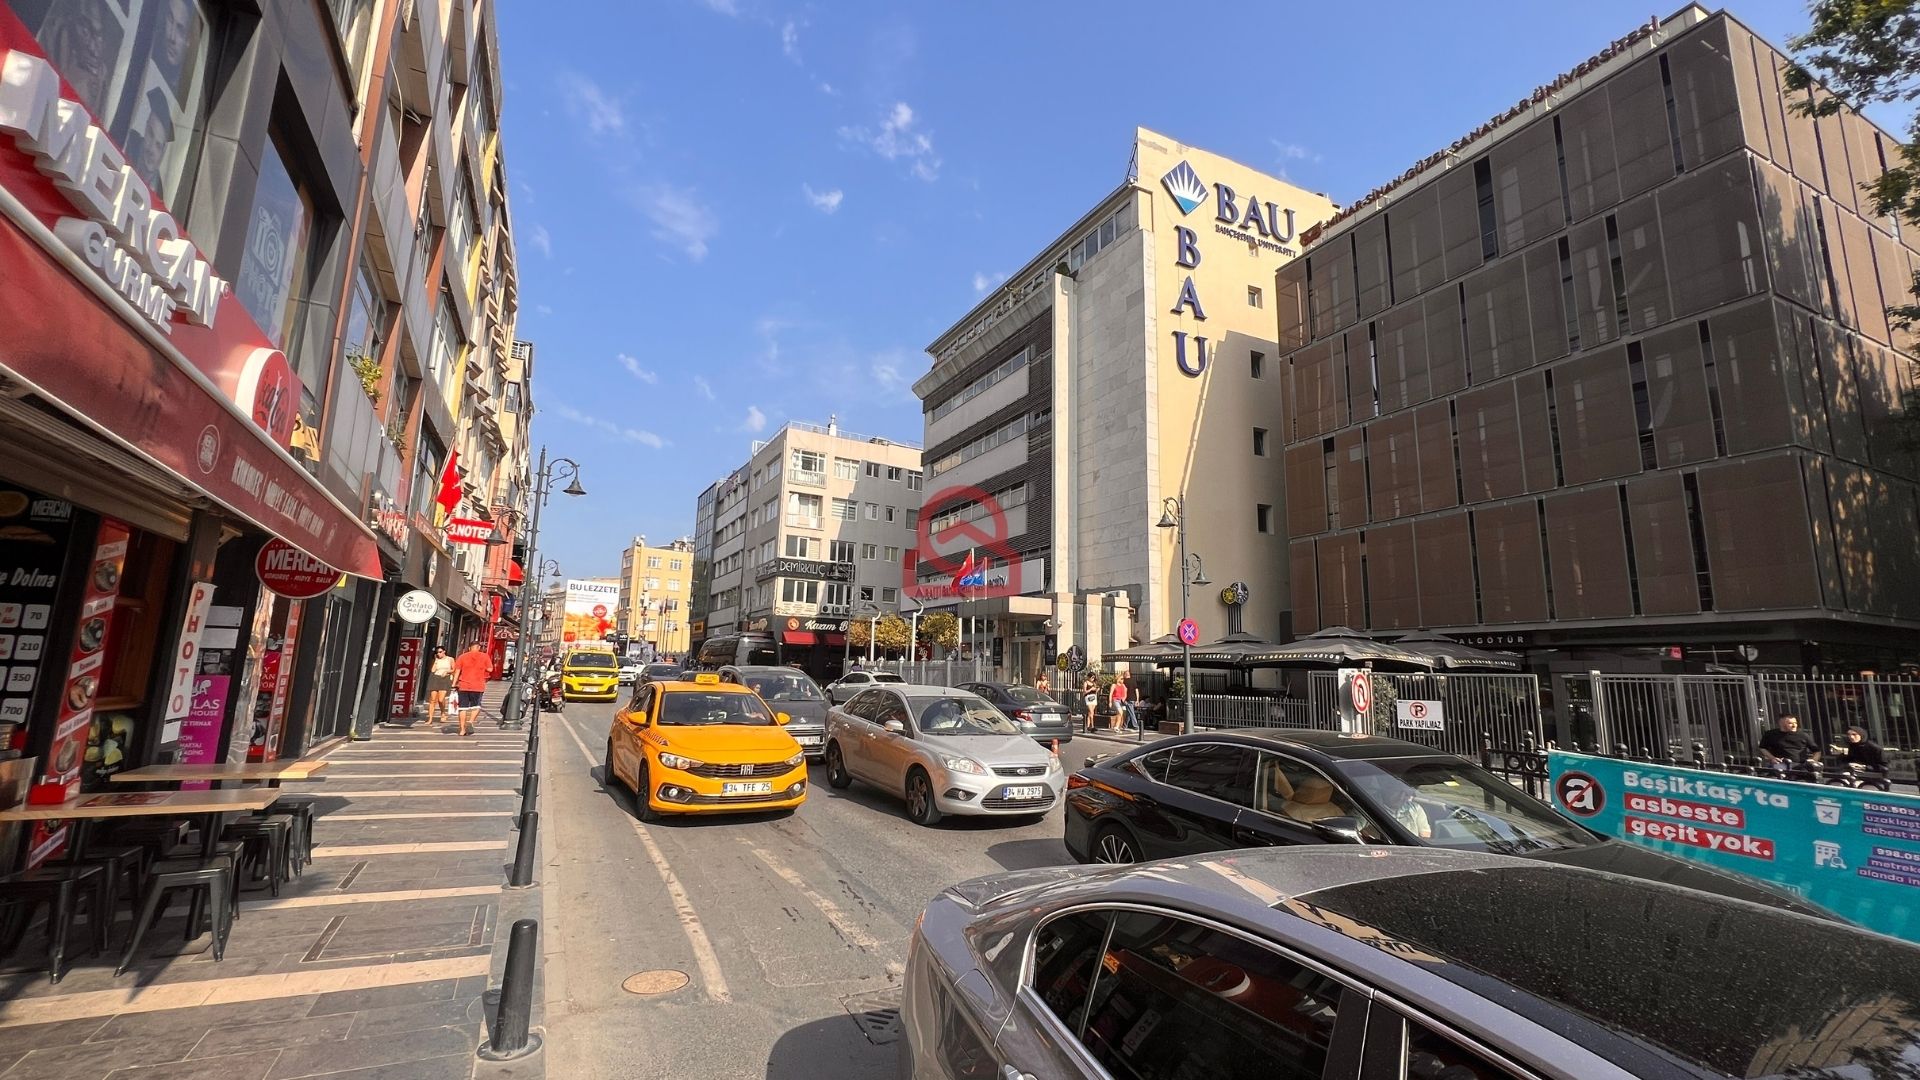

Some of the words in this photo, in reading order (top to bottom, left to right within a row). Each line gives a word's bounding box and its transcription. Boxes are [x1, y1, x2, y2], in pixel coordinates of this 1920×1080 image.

[0, 49, 222, 330] MERCAN
[1213, 182, 1296, 243] BAU
[55, 217, 177, 336] GURME
[1171, 225, 1208, 378] BAU
[30, 500, 72, 519] MERCAN
[449, 524, 492, 538] 3.NOTER
[10, 568, 56, 587] Dolma
[570, 583, 582, 591] BU
[583, 585, 618, 593] LEZZETE
[403, 600, 433, 610] Gelato
[30, 611, 42, 620] 70
[20, 642, 39, 651] 210
[171, 589, 205, 714] PHOTO
[12, 673, 31, 682] 350
[4, 706, 23, 715] 700
[1399, 719, 1413, 728] PARK
[1414, 720, 1441, 729] YAPILMAZ
[740, 764, 754, 775] FIAT
[729, 784, 737, 792] 34
[743, 784, 756, 792] TFE
[761, 783, 770, 791] 25
[1008, 788, 1015, 796] 34
[1027, 787, 1041, 795] 2975
[1623, 771, 1789, 808] Beşiktaş'ta
[1630, 798, 1739, 825] asbeste
[1631, 820, 1699, 842] geçit
[1706, 836, 1771, 856] yok.
[1864, 827, 1908, 838] asbest
[1859, 869, 1904, 883] alanda
